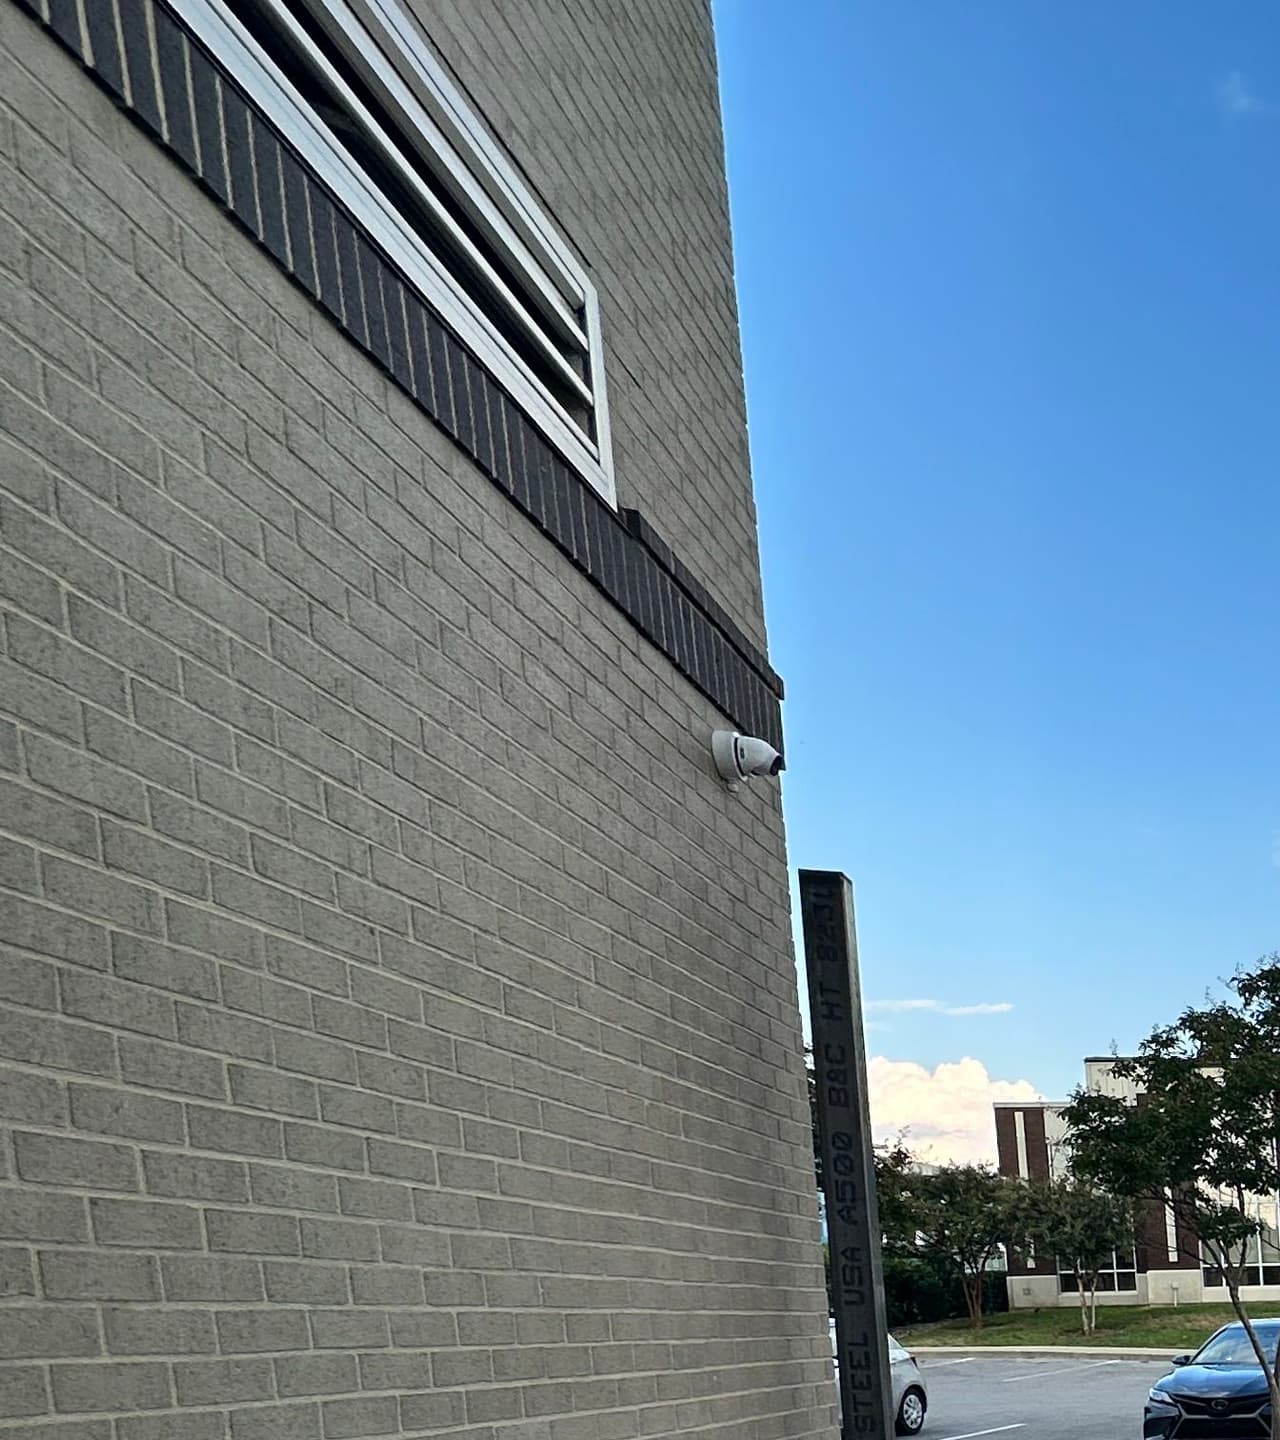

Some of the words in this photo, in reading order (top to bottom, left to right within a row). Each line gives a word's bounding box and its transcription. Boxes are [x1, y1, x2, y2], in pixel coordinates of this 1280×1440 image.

[818, 978, 844, 1022] HT
[824, 1042, 850, 1109] B&C
[832, 1130, 859, 1227] A500
[840, 1245, 865, 1306] USA
[849, 1331, 875, 1433] STEEL
